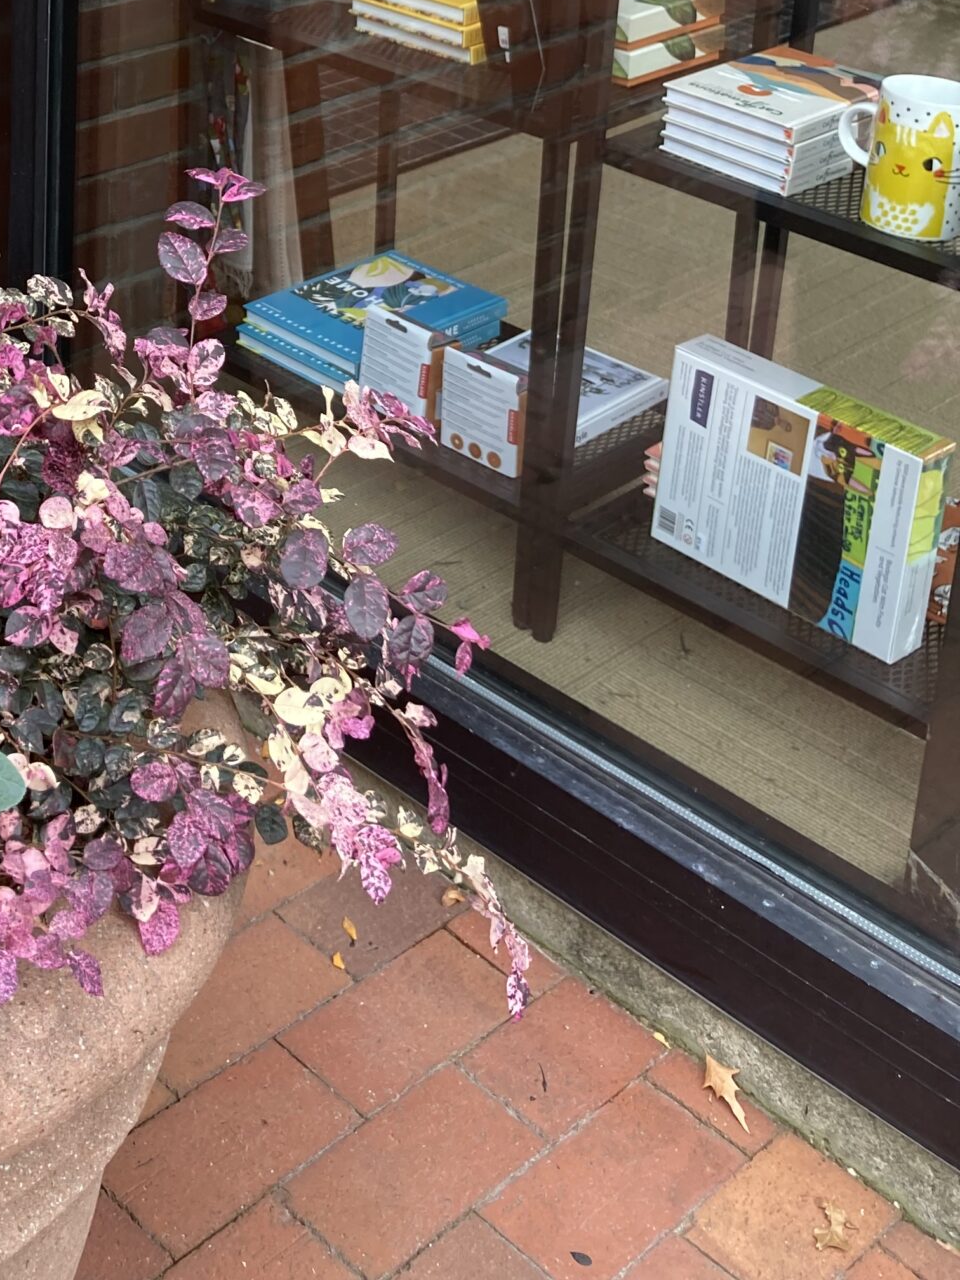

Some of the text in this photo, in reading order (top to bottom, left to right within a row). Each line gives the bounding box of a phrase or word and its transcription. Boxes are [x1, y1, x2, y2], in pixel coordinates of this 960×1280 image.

[324, 275, 386, 310] HOME
[695, 375, 707, 419] KINSTLER
[831, 566, 861, 620] Heads
